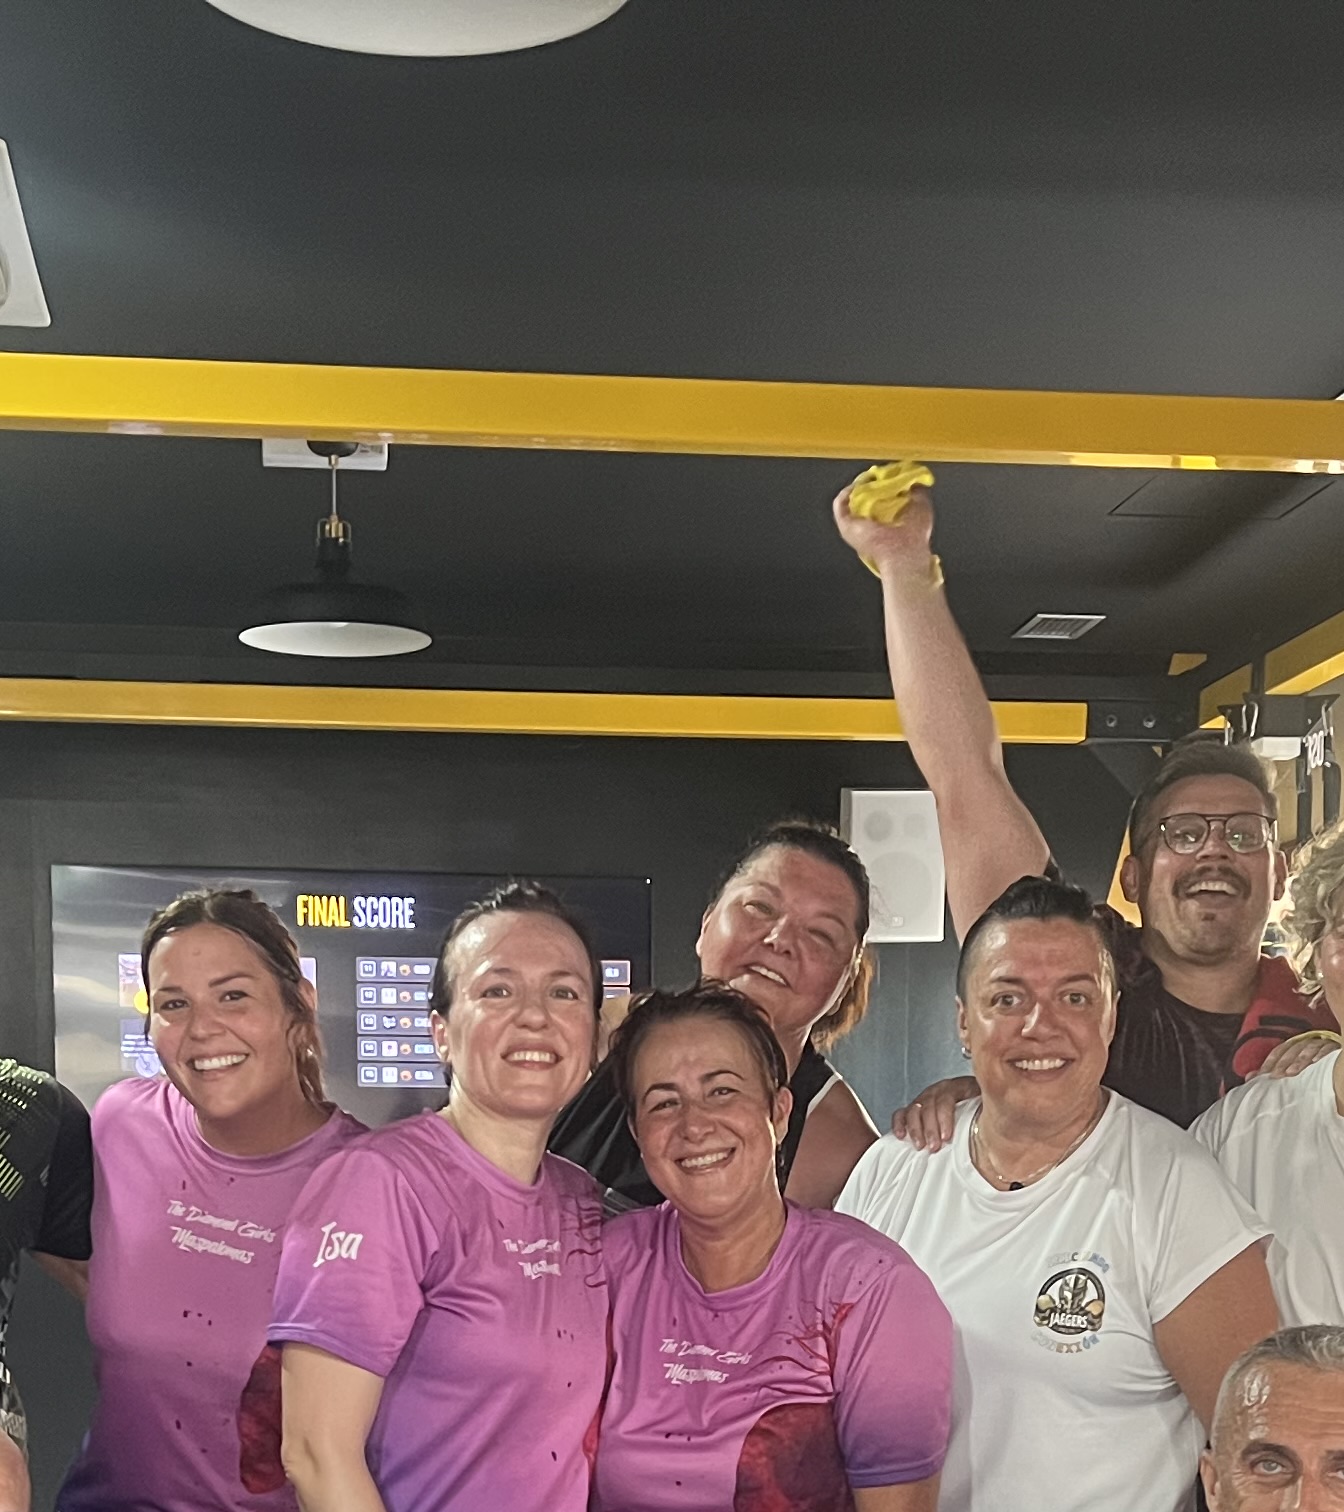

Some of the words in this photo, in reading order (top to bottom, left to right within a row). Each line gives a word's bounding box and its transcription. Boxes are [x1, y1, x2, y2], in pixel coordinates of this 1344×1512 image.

[296, 894, 351, 928] FINAL
[352, 896, 416, 930] SCORE
[312, 1221, 364, 1268] Isa
[1048, 1311, 1089, 1329] JAEGERS
